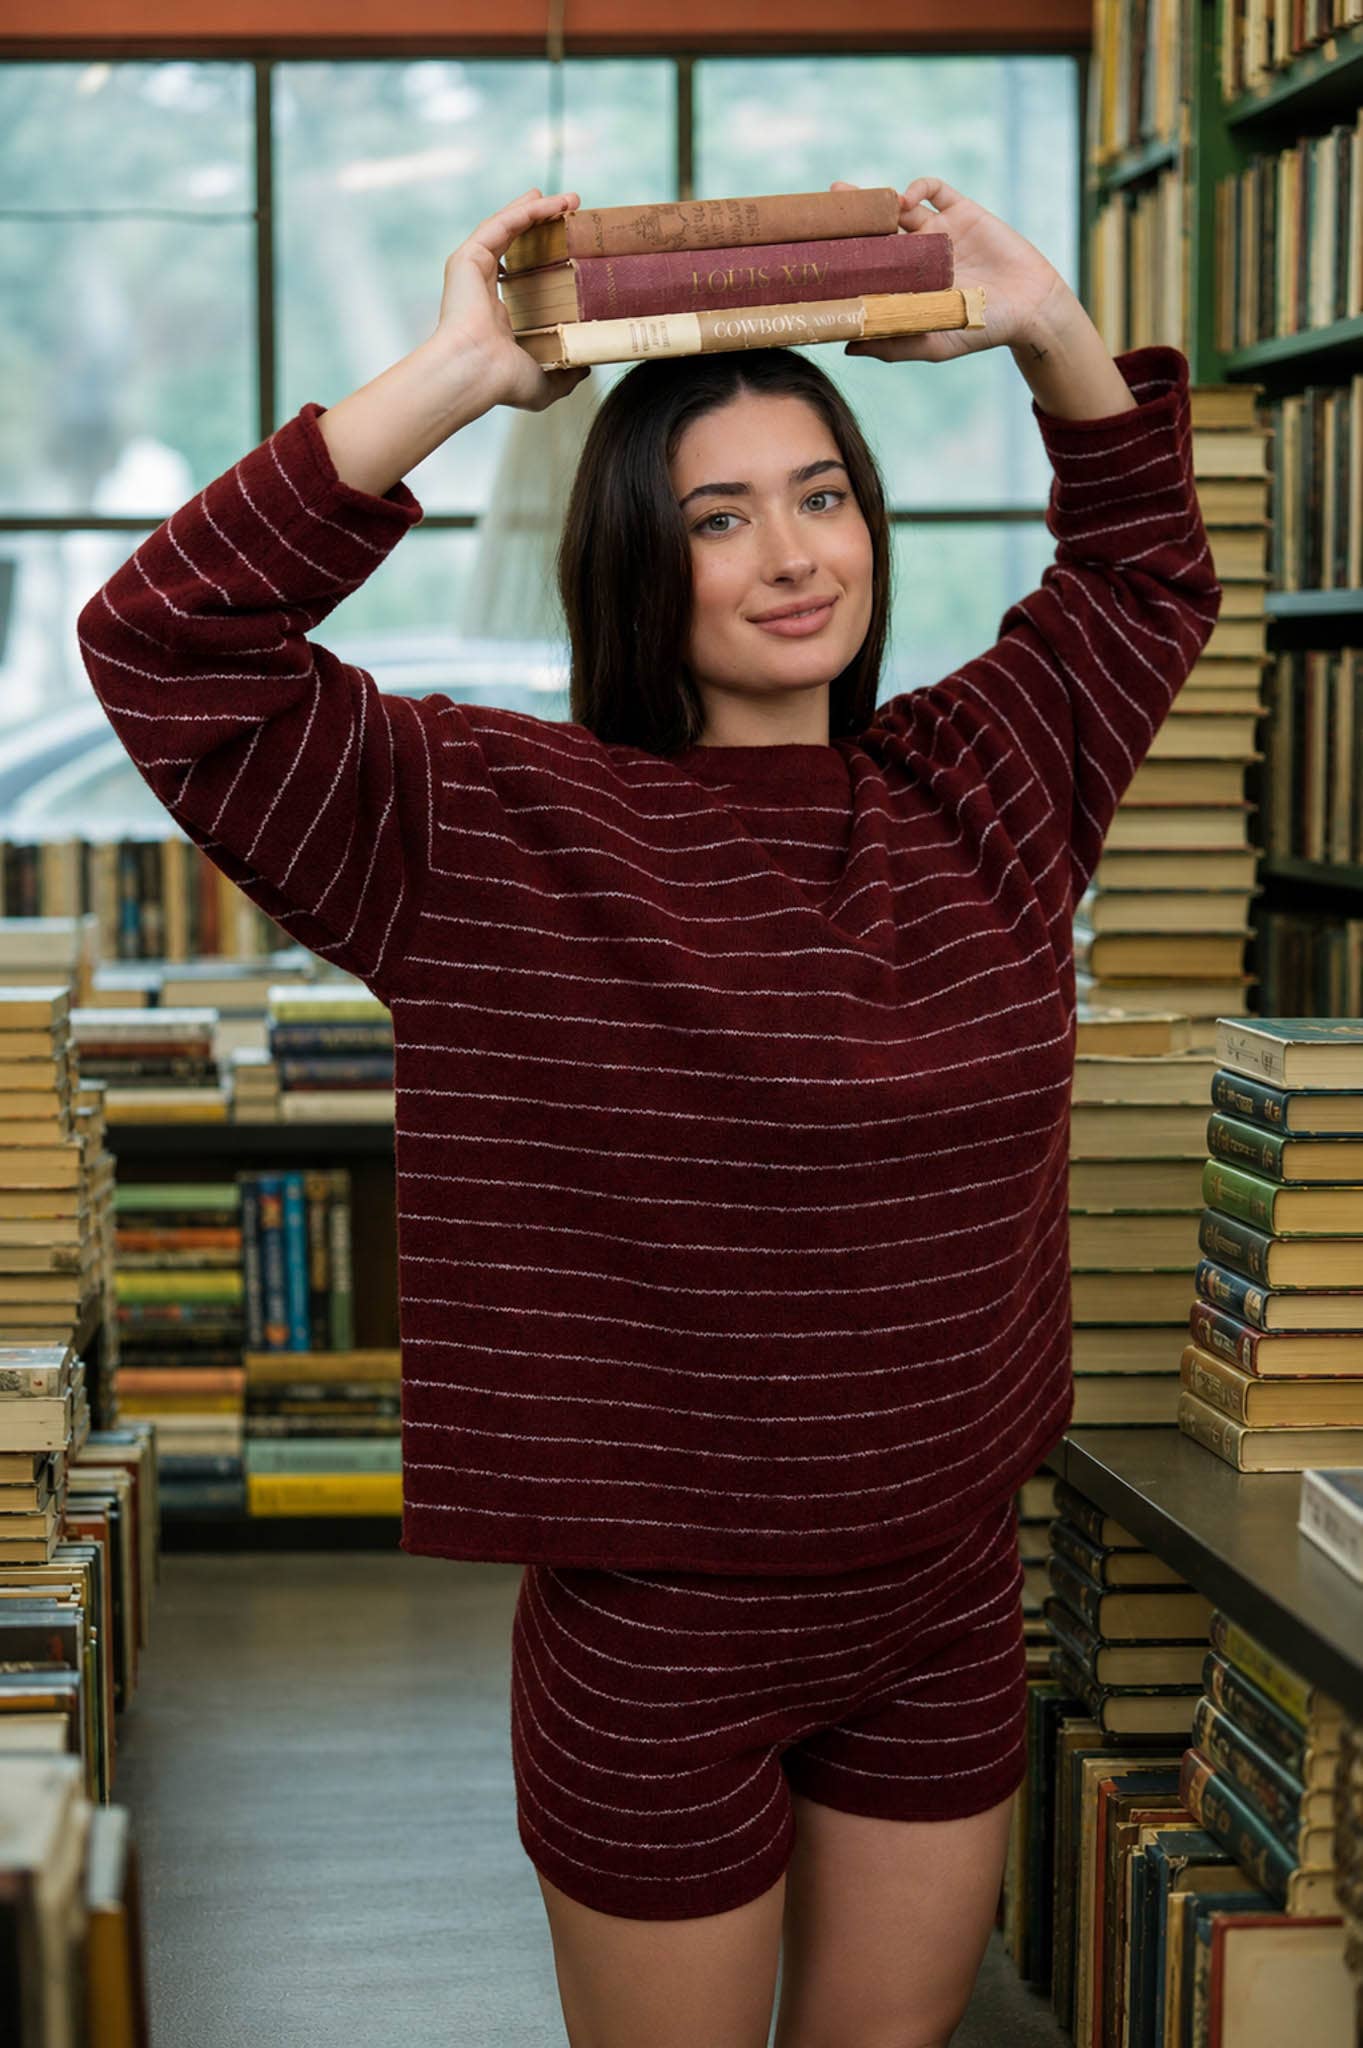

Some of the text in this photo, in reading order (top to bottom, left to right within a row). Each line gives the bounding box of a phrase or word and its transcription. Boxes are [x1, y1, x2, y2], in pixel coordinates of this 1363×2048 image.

[690, 262, 829, 293] LOUIS XIV
[713, 315, 807, 338] COWBOYS
